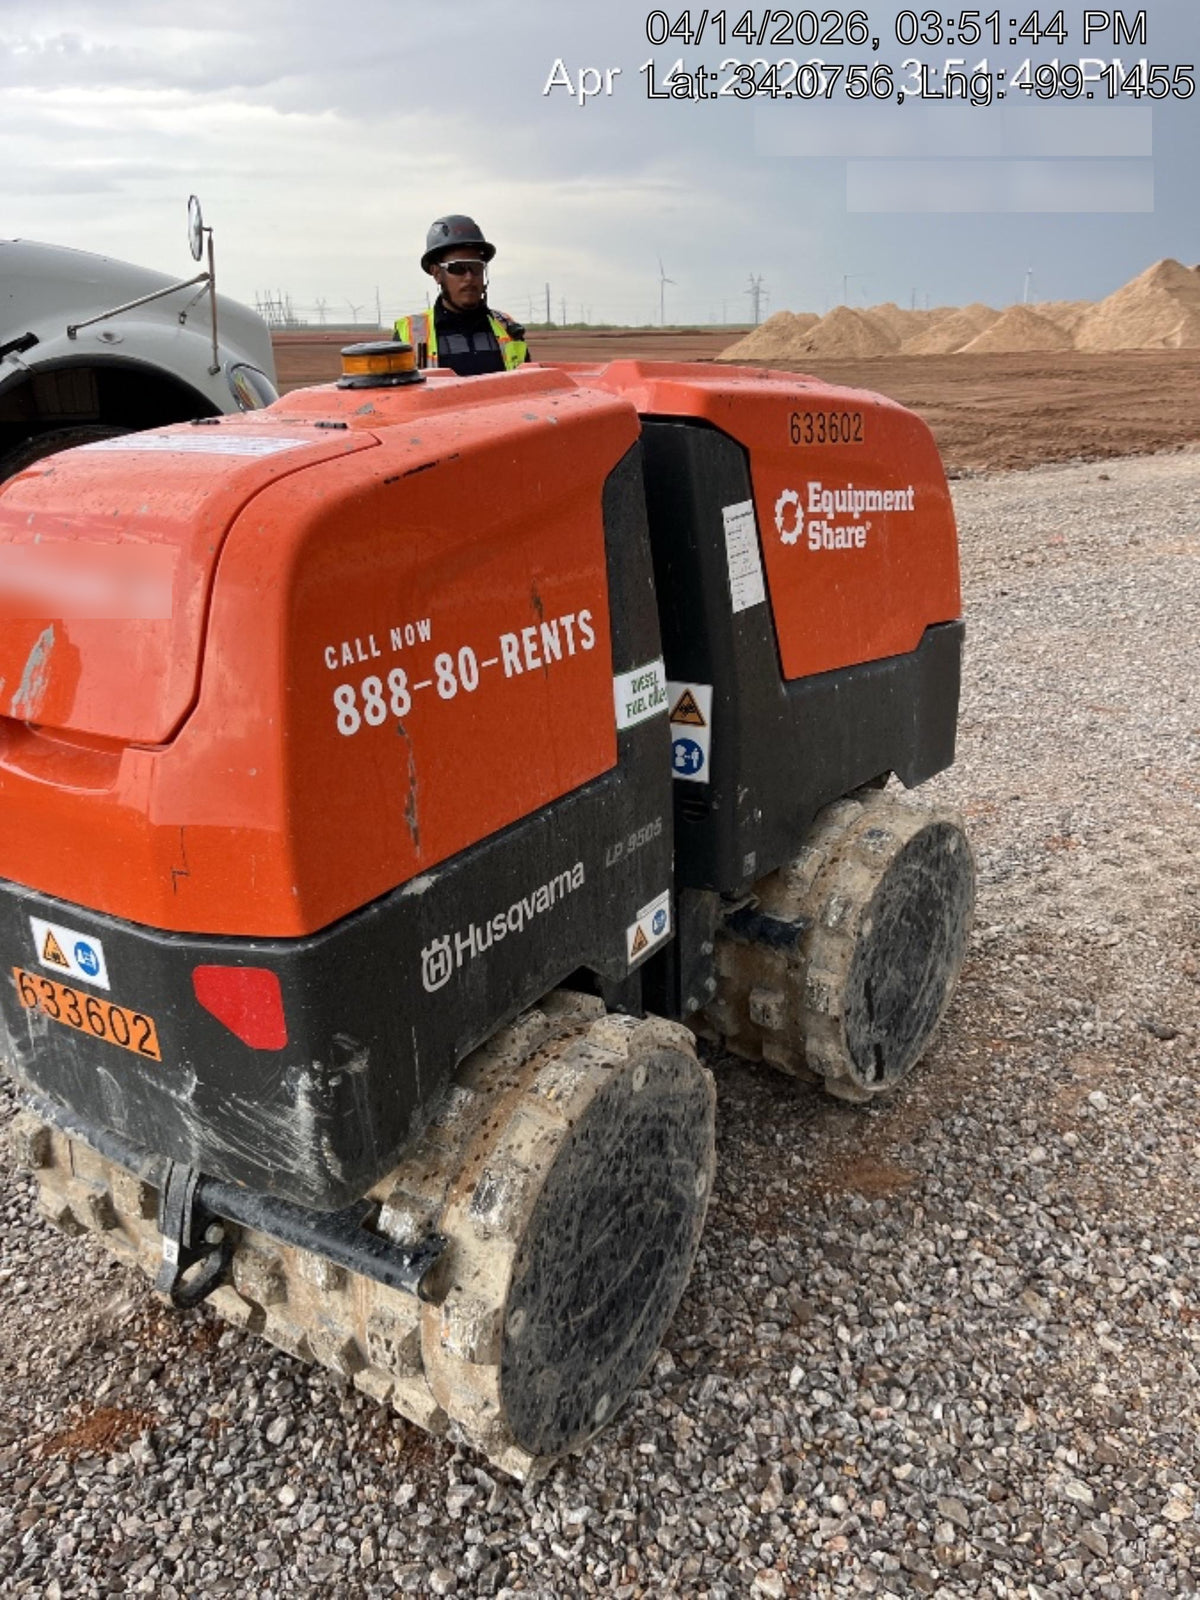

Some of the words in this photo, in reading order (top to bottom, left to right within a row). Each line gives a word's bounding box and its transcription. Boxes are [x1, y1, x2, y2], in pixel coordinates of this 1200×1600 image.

[790, 412, 863, 445] 633602
[807, 481, 915, 520] Equipment
[324, 634, 381, 670] CALL
[389, 618, 432, 651] NOW
[333, 609, 596, 736] 888-80-RENTS
[625, 696, 648, 719] FUEL
[606, 841, 623, 868] LP
[455, 861, 586, 968] Husqvarna
[19, 972, 156, 1057] 633602
